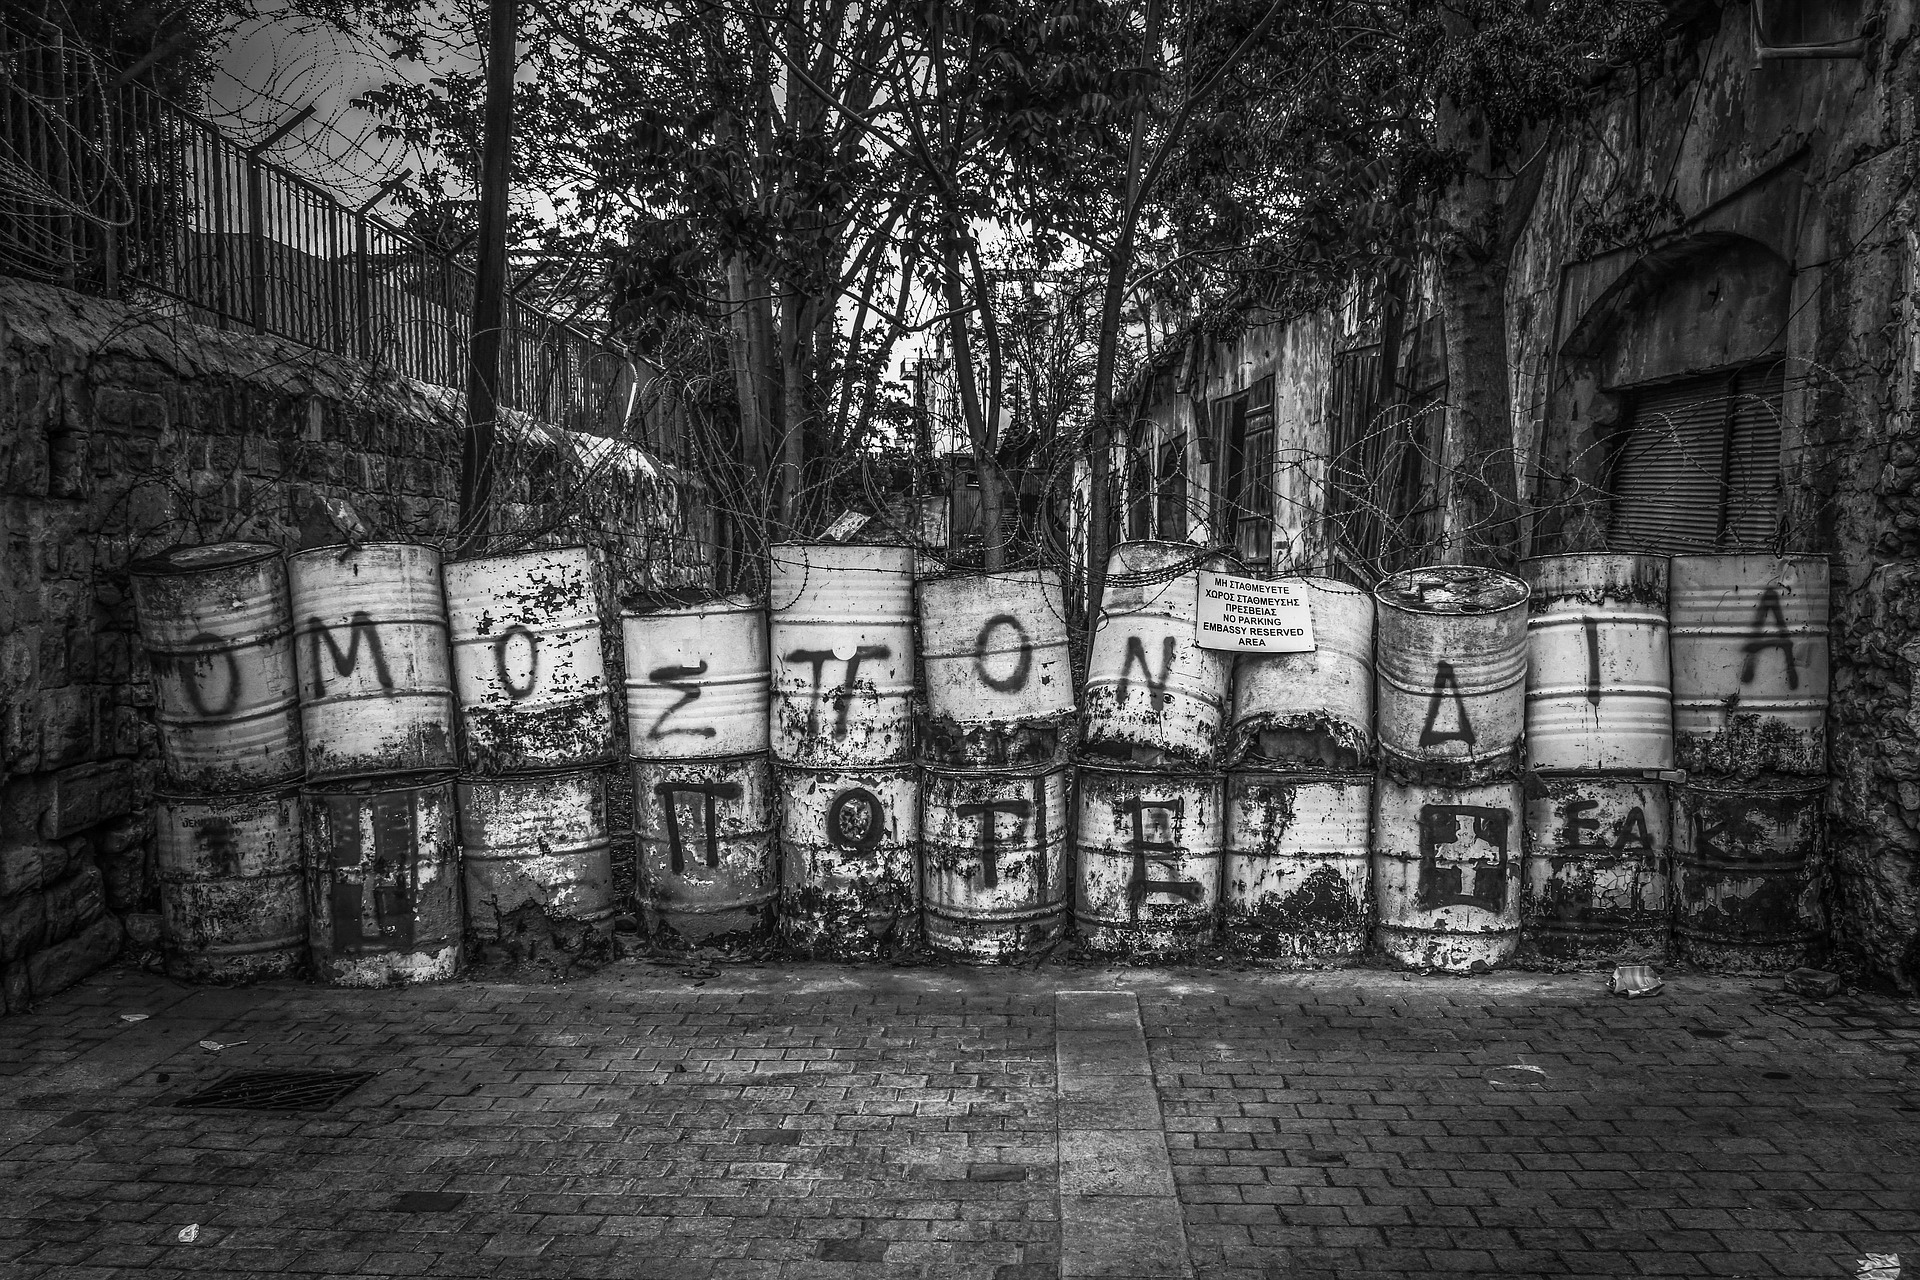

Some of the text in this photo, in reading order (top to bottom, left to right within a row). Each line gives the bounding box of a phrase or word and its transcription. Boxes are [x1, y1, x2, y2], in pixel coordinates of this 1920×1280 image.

[1214, 577, 1290, 595] ΜΗ ΣΤΑΘΜΕΥΕΤΕ
[1205, 588, 1300, 607] ΧΩΡΟΣ ΣΤΑΘΜΕΥΣΗΣ
[1225, 603, 1278, 616] ΠΡΕΣΒΕΙΑΣ
[1223, 613, 1282, 626] NO PARKING
[1203, 622, 1304, 637] EMBASSY RESERVED
[1238, 637, 1267, 647] AREA
